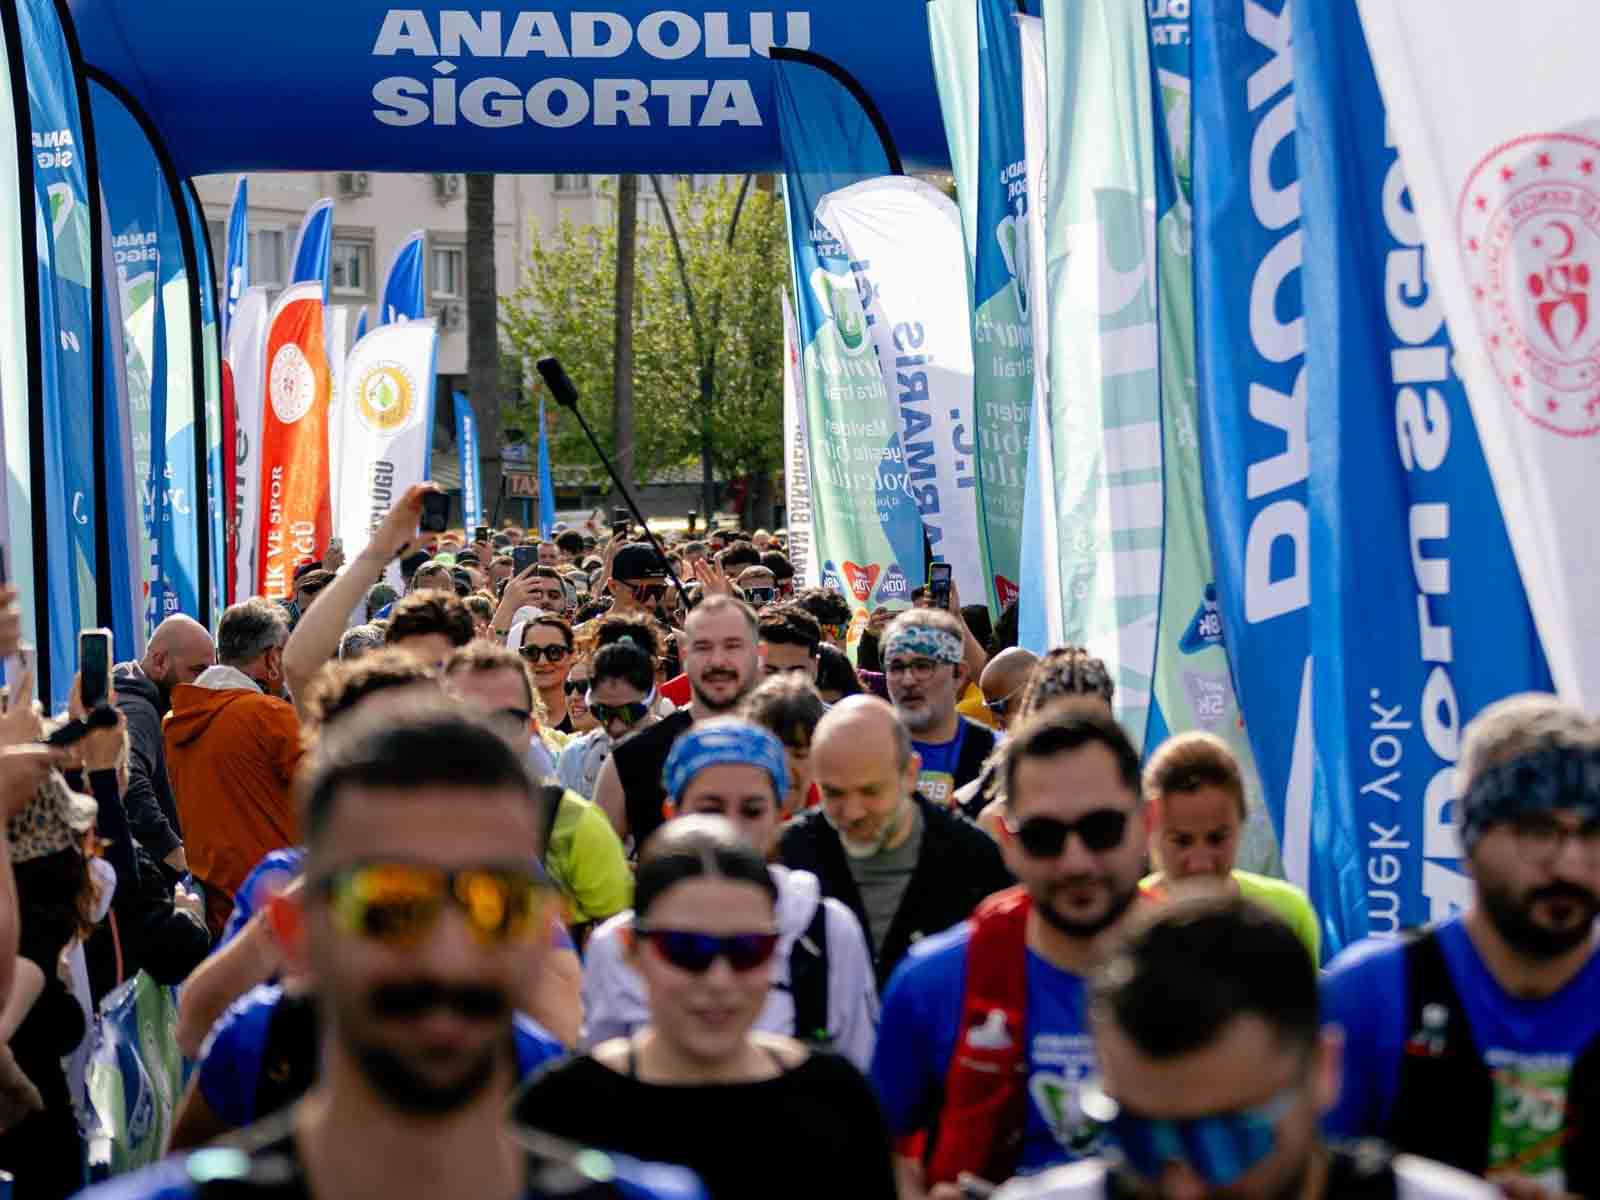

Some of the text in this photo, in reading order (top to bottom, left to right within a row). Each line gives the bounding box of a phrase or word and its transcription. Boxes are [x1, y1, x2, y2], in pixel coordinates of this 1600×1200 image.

[372, 9, 811, 59] ANADOLU
[372, 60, 762, 128] SİGORTA
[267, 464, 283, 525] SPOR
[265, 529, 285, 559] VE
